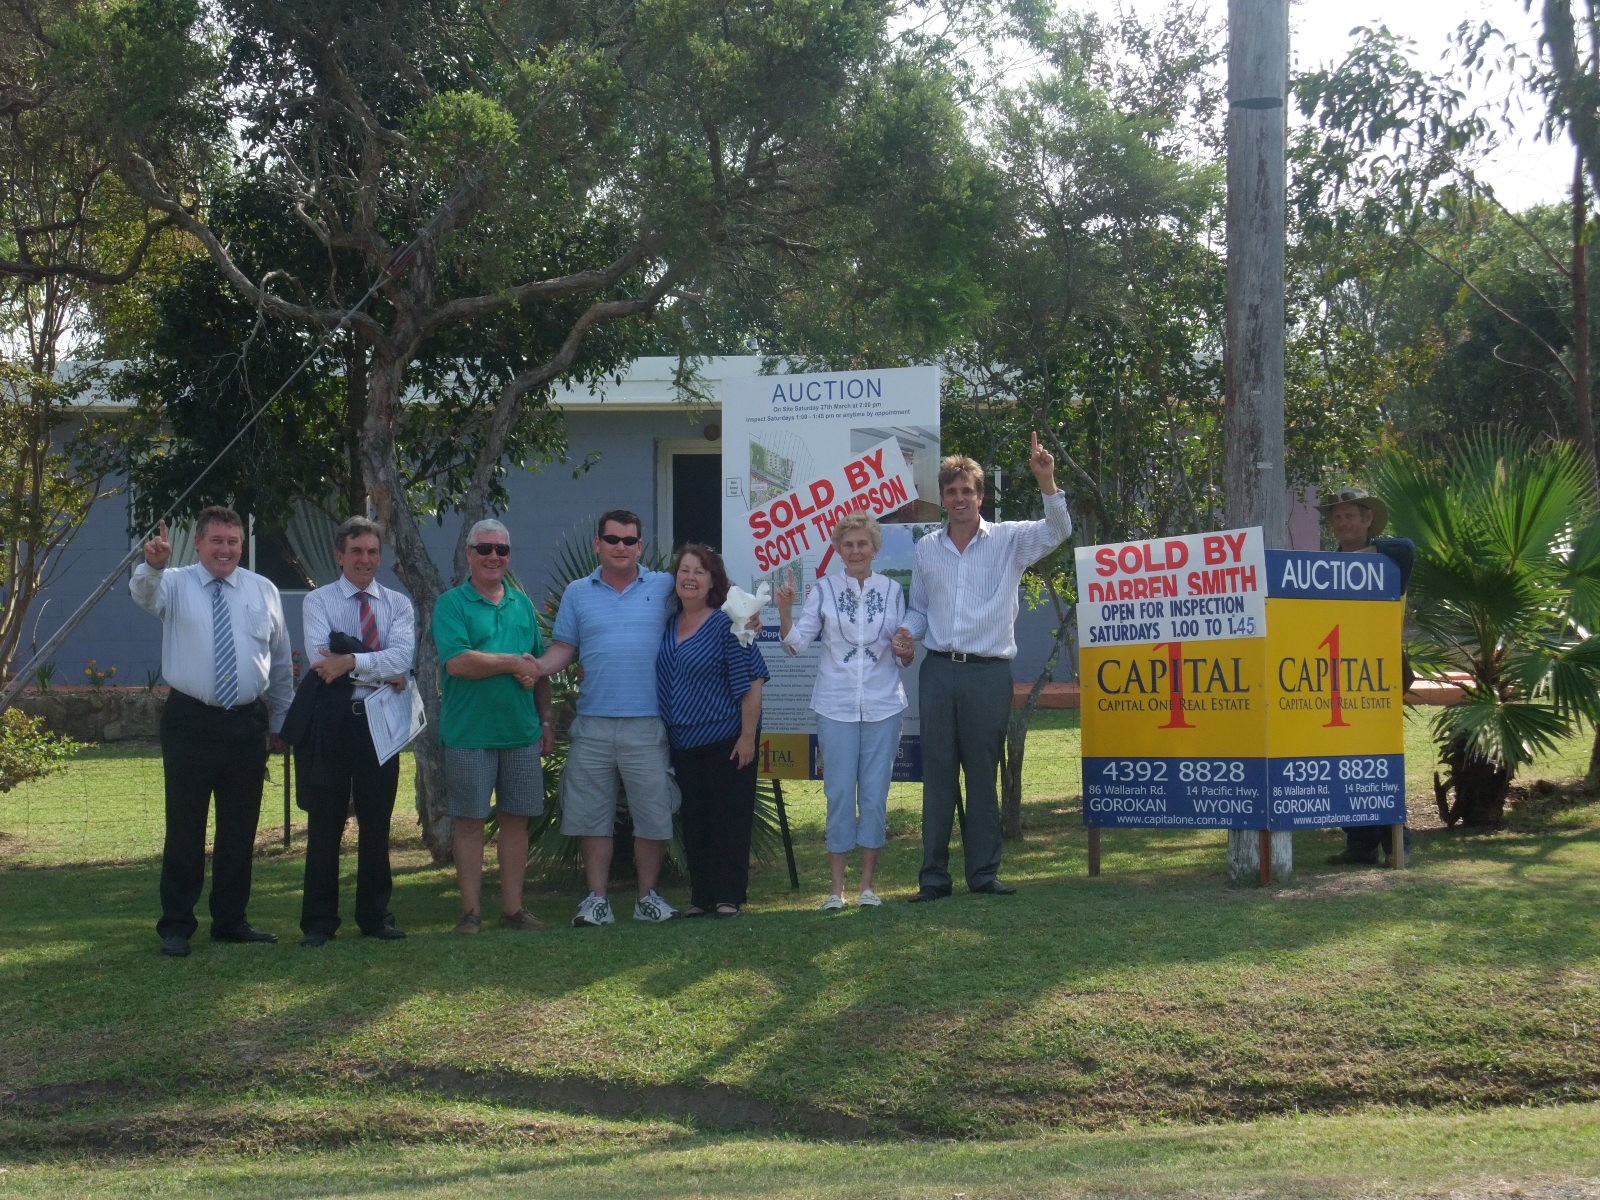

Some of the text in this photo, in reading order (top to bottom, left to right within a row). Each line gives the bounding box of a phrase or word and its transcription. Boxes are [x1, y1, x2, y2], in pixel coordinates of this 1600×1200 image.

[772, 378, 882, 403] AUCTION
[843, 411, 865, 419] anytime
[874, 409, 911, 417] appointment
[749, 448, 885, 539] SOLD BY
[755, 523, 810, 572] SCOTT
[1095, 532, 1247, 577] SOLD BY
[1088, 564, 1257, 603] DARREN SMITH
[1281, 559, 1384, 591] AUCTION
[1102, 596, 1245, 621] OPEN FOR INSPECTION
[1089, 616, 1256, 643] SATURDAYS 1.00 TO 1.45
[1097, 658, 1250, 695] CAPITAL
[1279, 657, 1390, 693] CAPITAL
[1102, 761, 1245, 782] 4392 8828
[1283, 759, 1388, 782] 4392 8828
[1088, 785, 1166, 795] 86 Wallarah Rd.
[1186, 785, 1260, 797] 14 Pacific Hwy.
[1272, 784, 1330, 797] 86 Wallarah Rd.
[1344, 782, 1399, 794] 14 Pacific Hwy.
[1089, 798, 1166, 812] GOROKAN
[1193, 799, 1253, 814] WYONG
[1273, 799, 1330, 814] GOROKAN
[1350, 795, 1395, 810] WYONG
[1117, 815, 1233, 826] www.capitalone.com.au
[1294, 813, 1379, 826] www.capitalone.com.au
